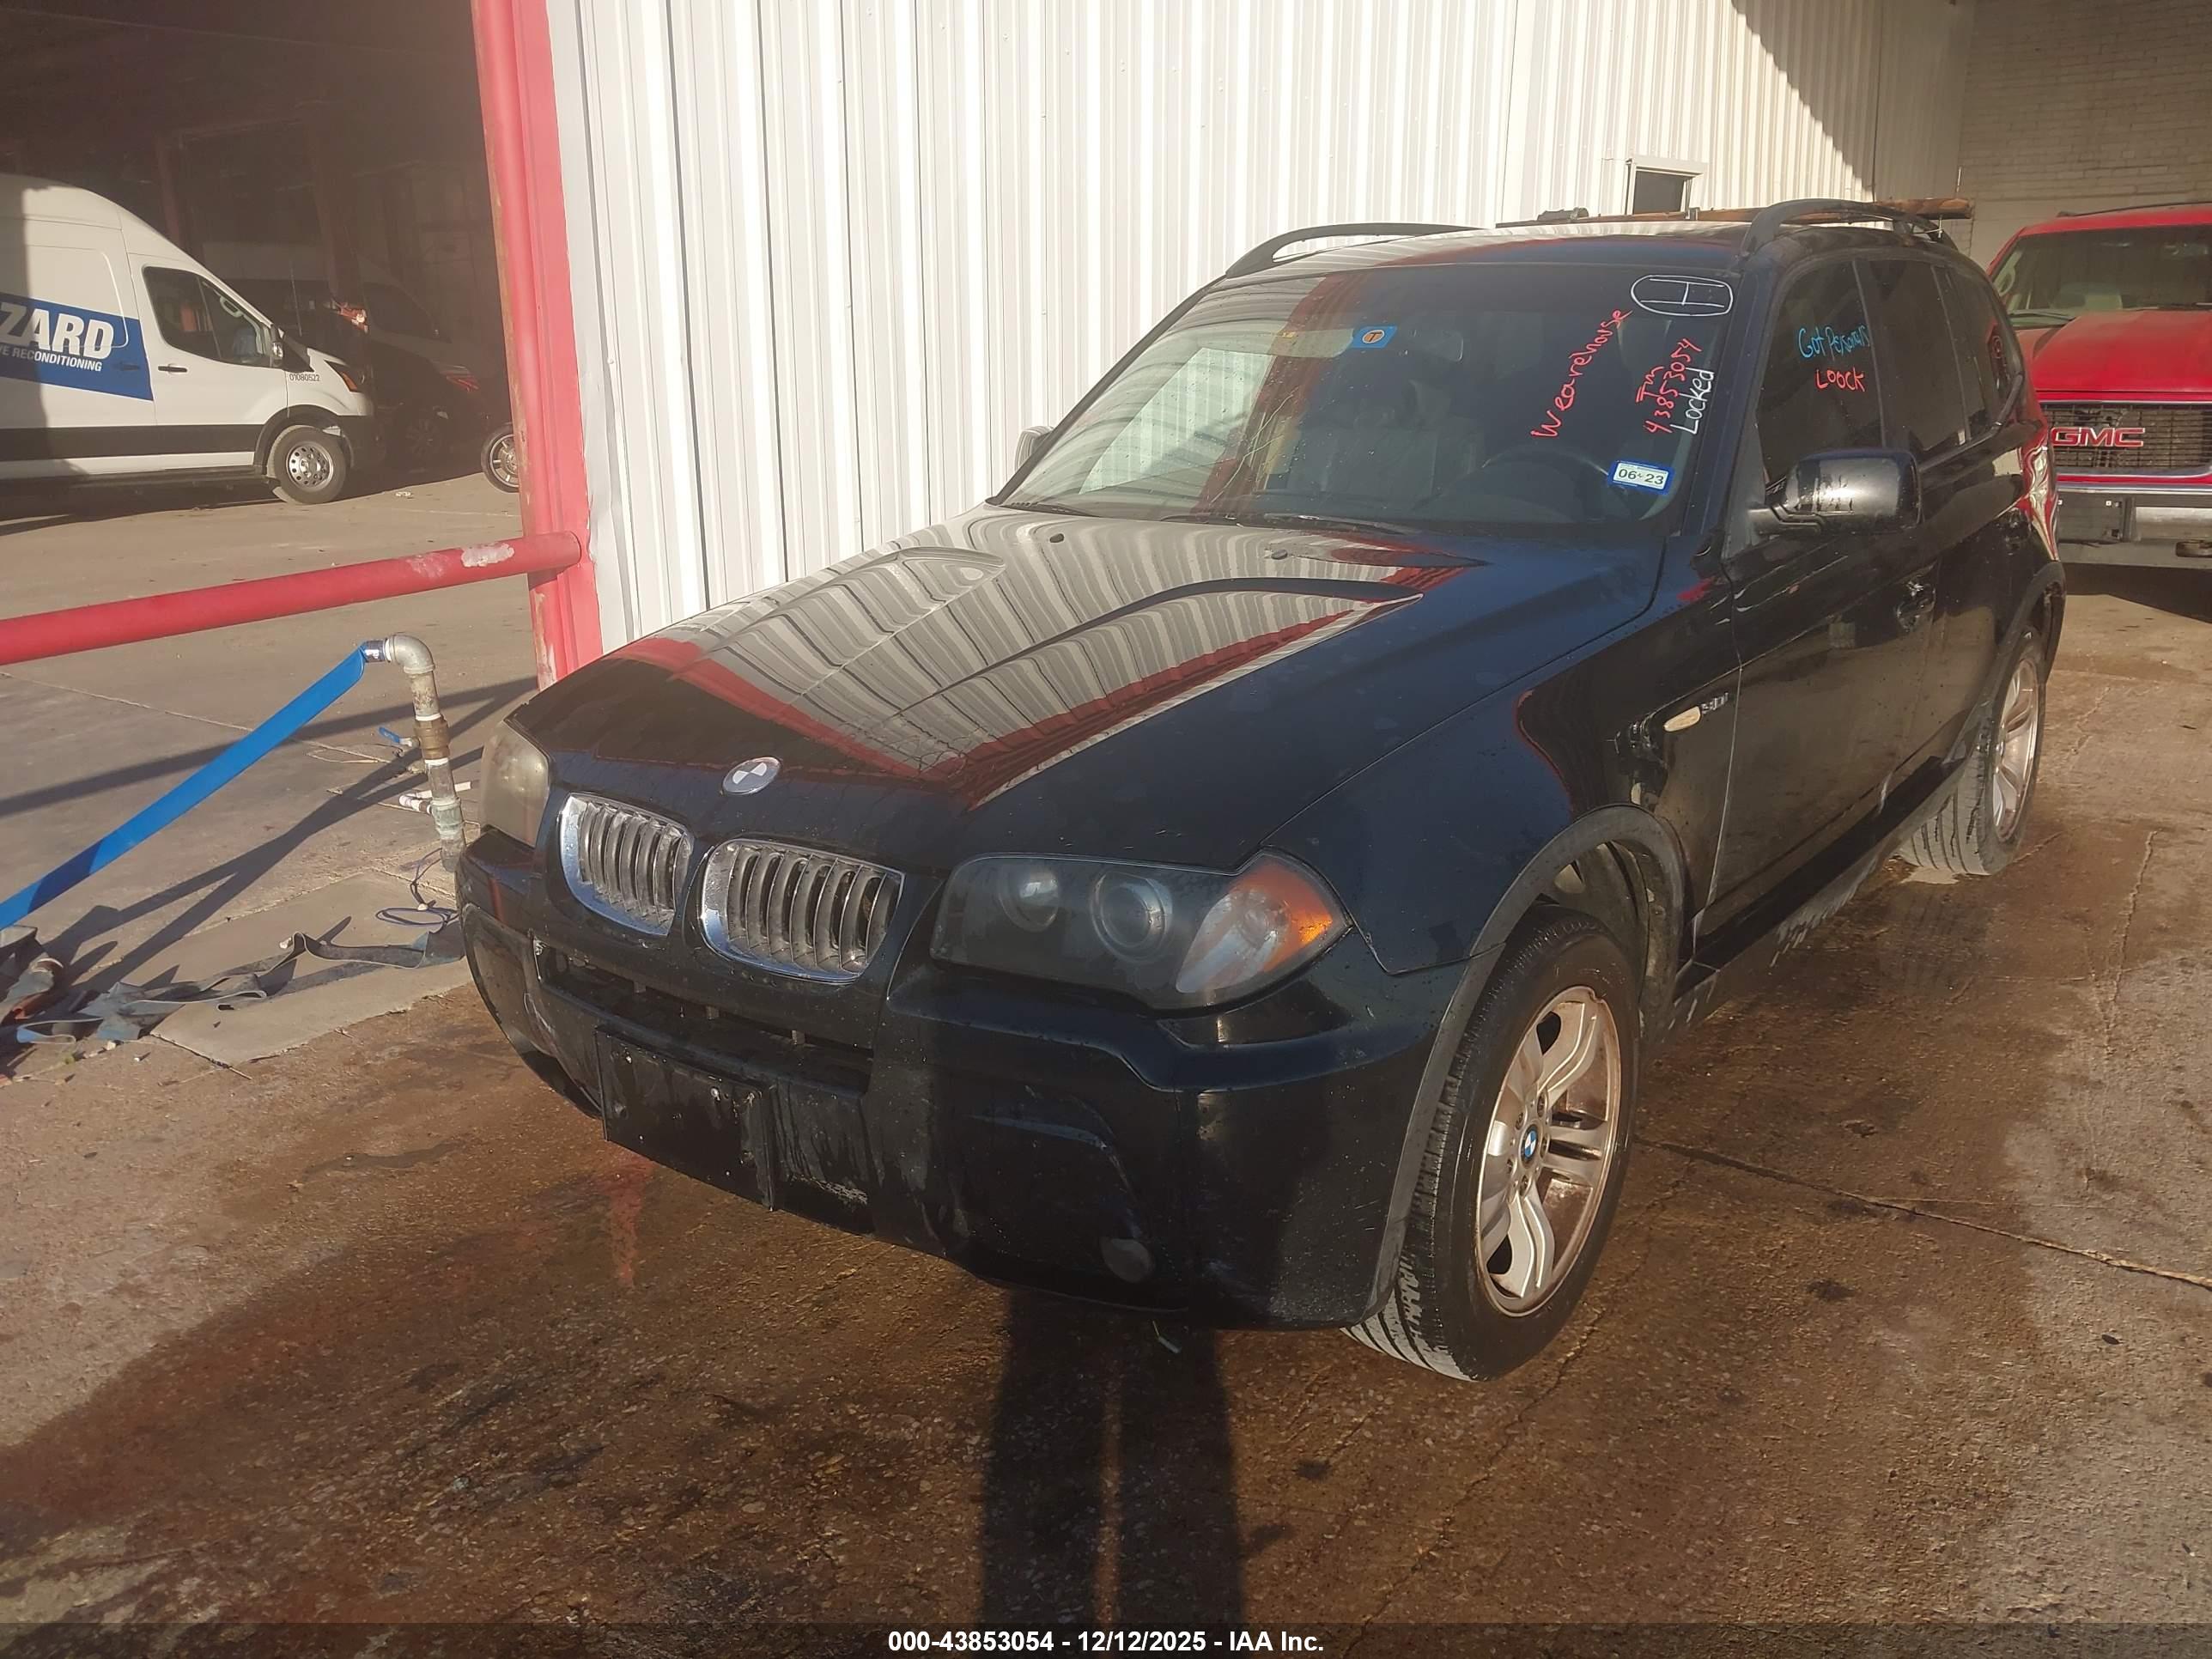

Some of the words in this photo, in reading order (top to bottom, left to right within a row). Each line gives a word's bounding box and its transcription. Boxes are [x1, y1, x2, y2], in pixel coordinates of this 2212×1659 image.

[11, 346, 102, 372] RECONDITIONING
[1643, 338, 1702, 434] 43853054
[1669, 367, 1715, 434] Locked
[2050, 427, 2146, 447] GMC
[1618, 468, 1638, 480] 06
[1644, 473, 1664, 485] 23
